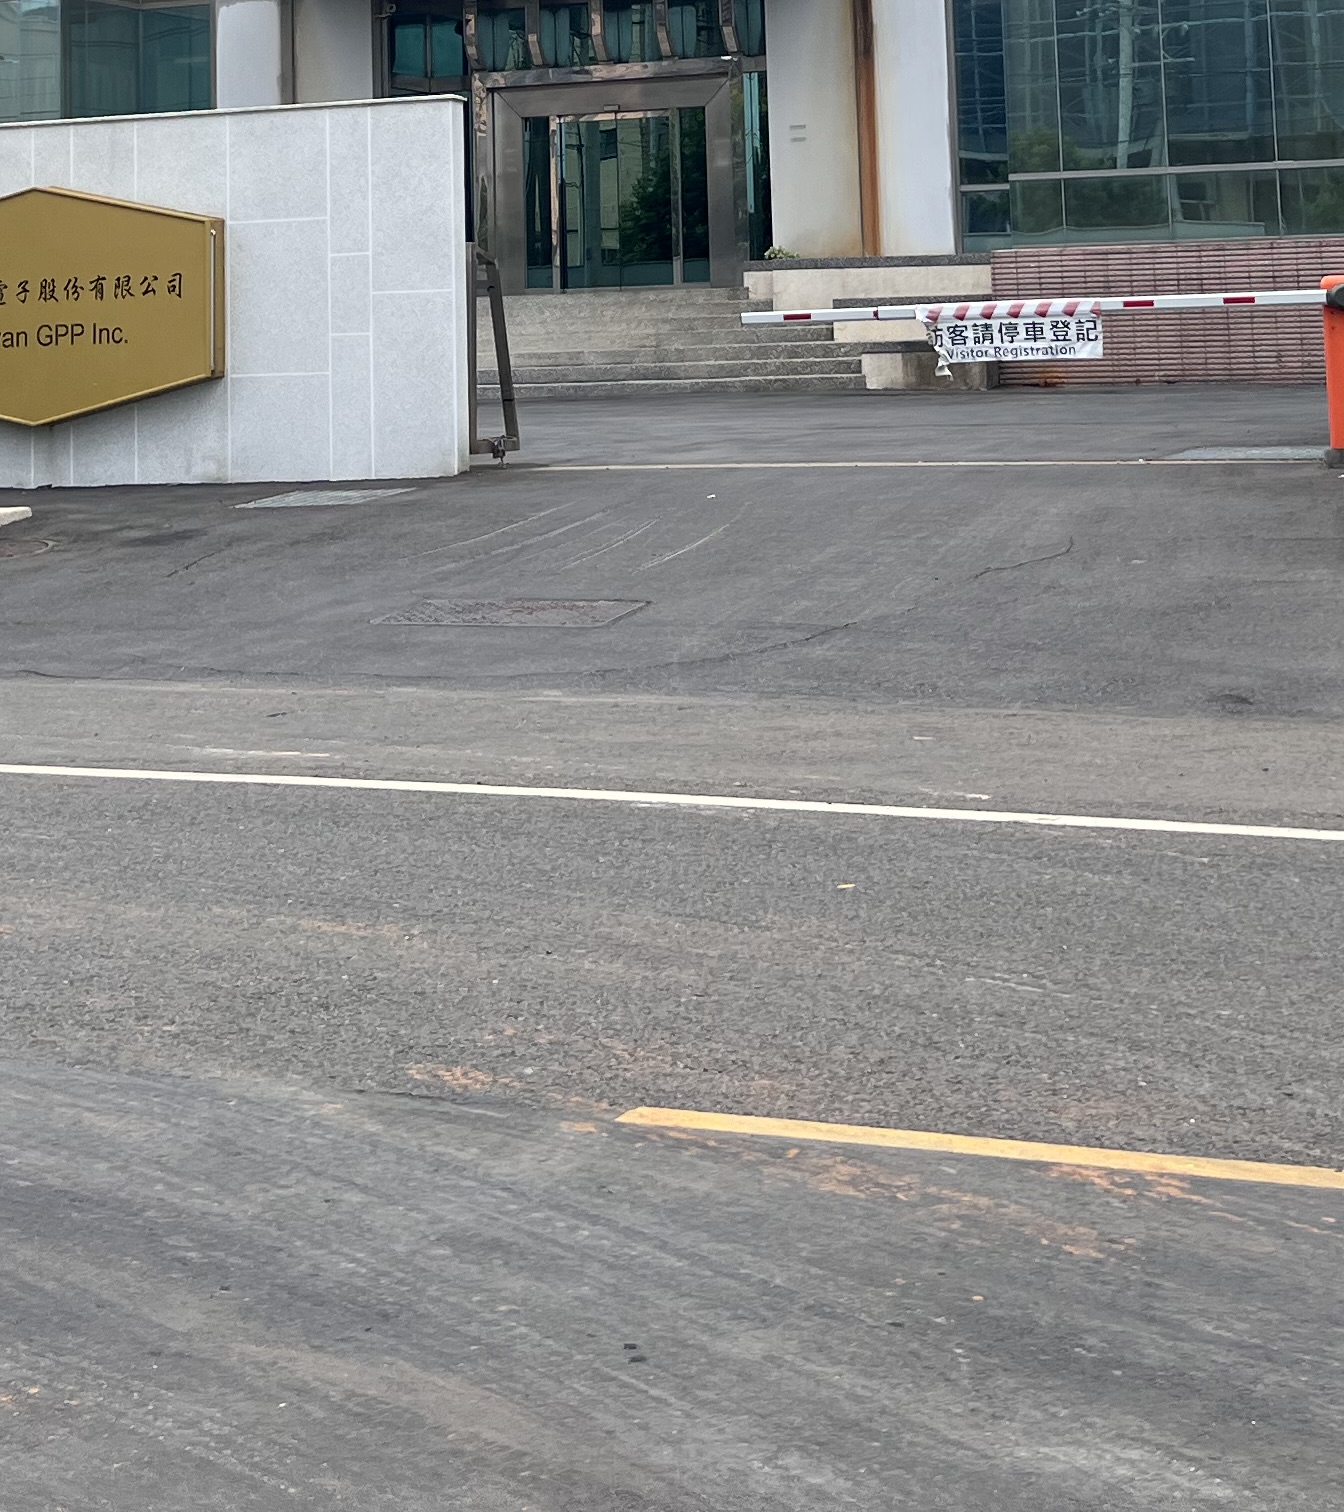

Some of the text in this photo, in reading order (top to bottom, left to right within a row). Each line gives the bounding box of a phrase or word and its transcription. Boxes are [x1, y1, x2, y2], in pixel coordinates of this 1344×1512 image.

[36, 323, 85, 347] GPP
[92, 322, 129, 345] Inc.
[945, 344, 1076, 360] Visitor Registration
